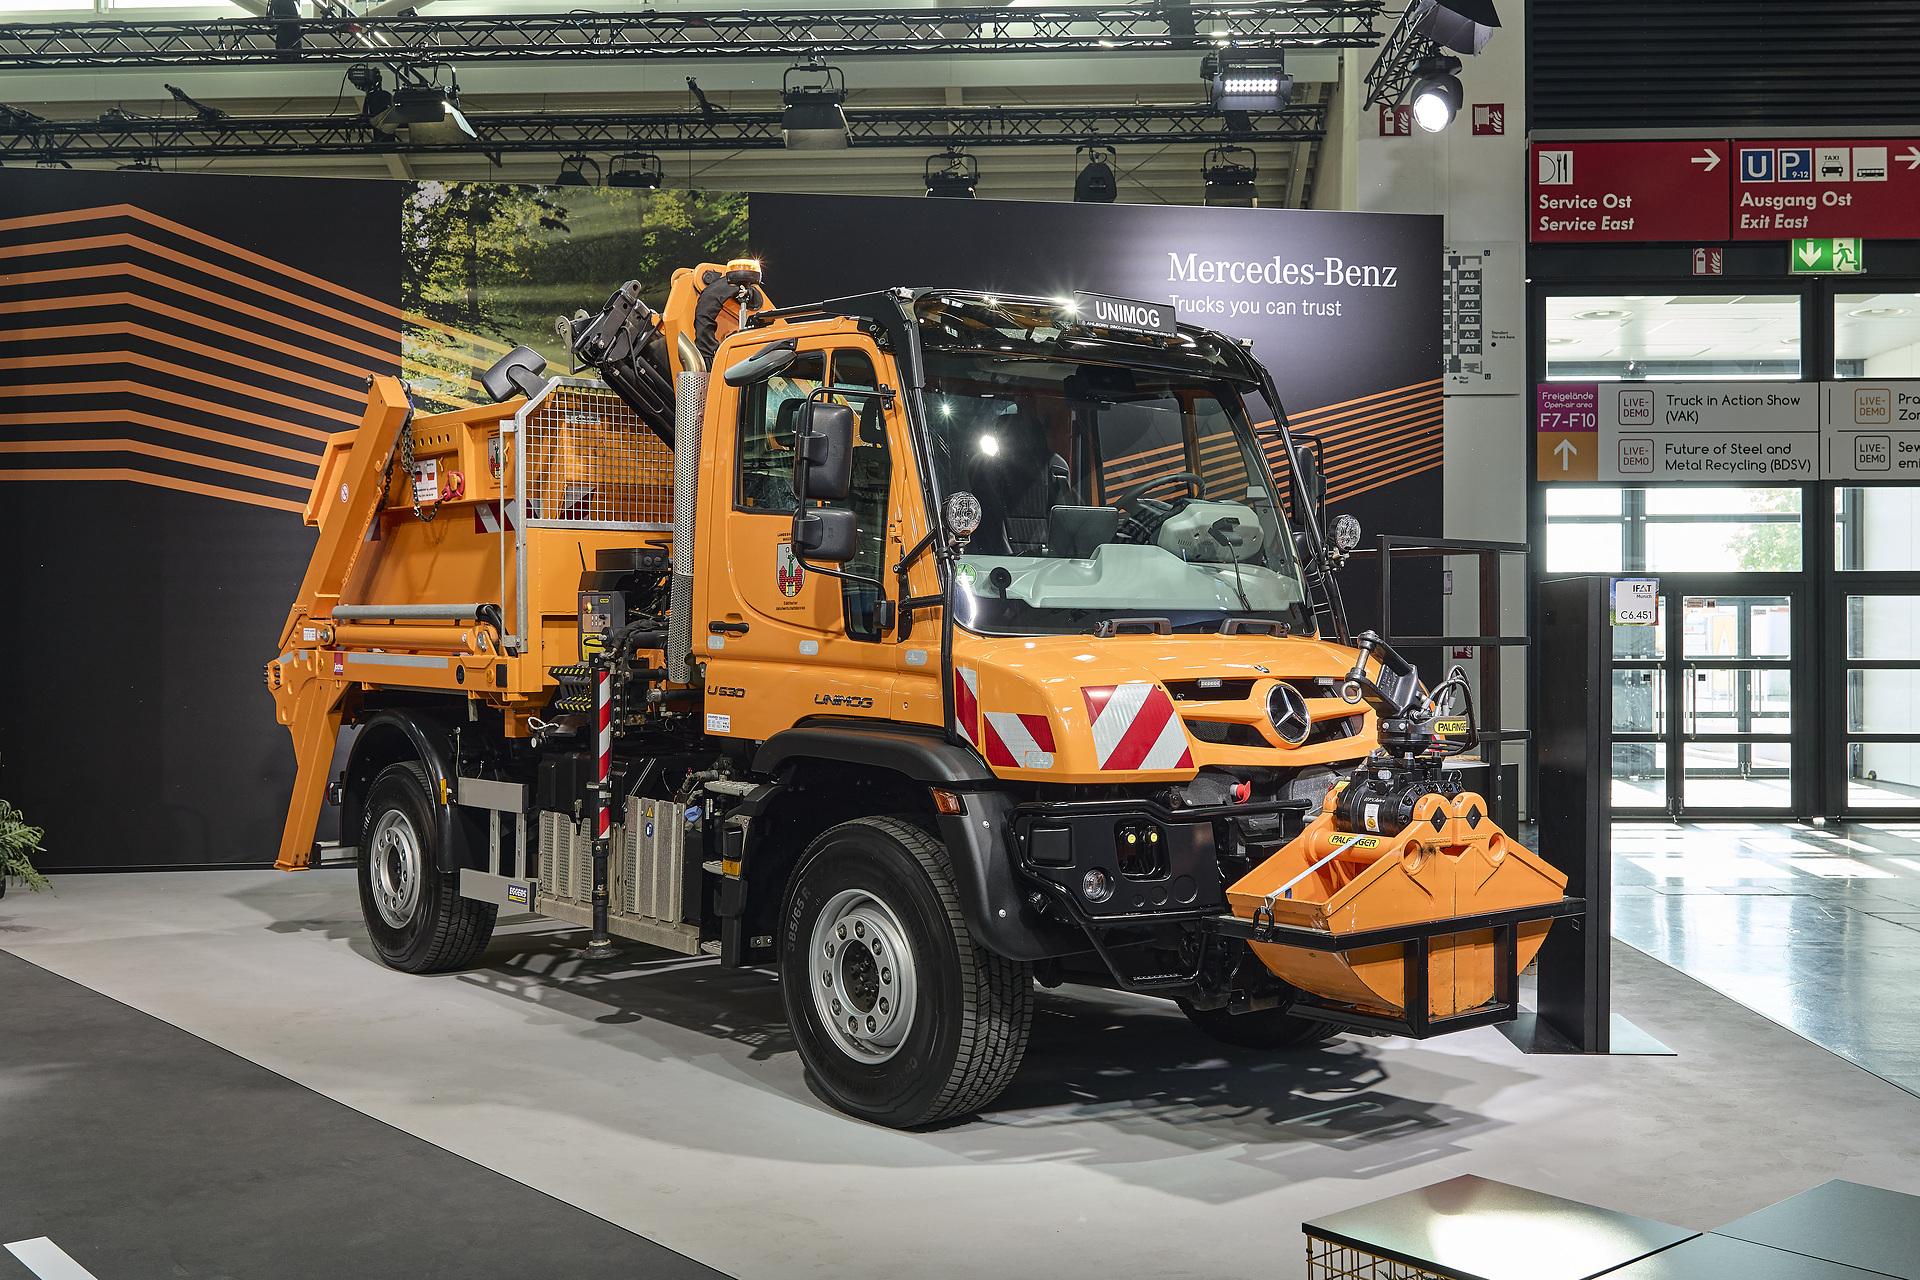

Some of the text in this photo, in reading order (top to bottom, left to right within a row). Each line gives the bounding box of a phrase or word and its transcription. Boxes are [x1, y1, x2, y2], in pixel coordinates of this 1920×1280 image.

[1748, 155, 1767, 178] U
[1782, 152, 1800, 178] P
[1539, 193, 1632, 209] Service Ost
[1740, 191, 1853, 211] Ausgang Ost
[1539, 215, 1635, 231] Service East
[1740, 213, 1809, 229] Exit East
[1167, 252, 1398, 288] Mercedes-Benz
[1169, 294, 1342, 318] Trucks you can trust
[1095, 300, 1161, 328] UNIMOG
[1542, 391, 1594, 401] Freigelände
[1623, 398, 1649, 407] LIVE-
[1666, 394, 1801, 406] Truck in Action Show
[1859, 396, 1886, 405] LIVE-
[1544, 401, 1575, 409] Open-air
[1859, 407, 1886, 416] DEMO
[1623, 408, 1649, 417] DEMO
[1665, 410, 1699, 424] (VAK)
[1540, 413, 1596, 428] F7-F10
[1623, 447, 1649, 455] LIVE-
[1665, 443, 1792, 454] Future of Steel and
[1859, 443, 1886, 452] LIVE-
[1623, 457, 1649, 465] DEMO
[1859, 454, 1886, 463] DEMO
[1665, 459, 1811, 473] Metal Recycling (BDSV)
[1632, 584, 1652, 592] IFAT
[1620, 610, 1652, 620] C6.451
[707, 685, 747, 699] U 530
[814, 693, 875, 708] UNIMOG
[1331, 835, 1377, 847] PALFNGER
[787, 897, 805, 952] 385/65
